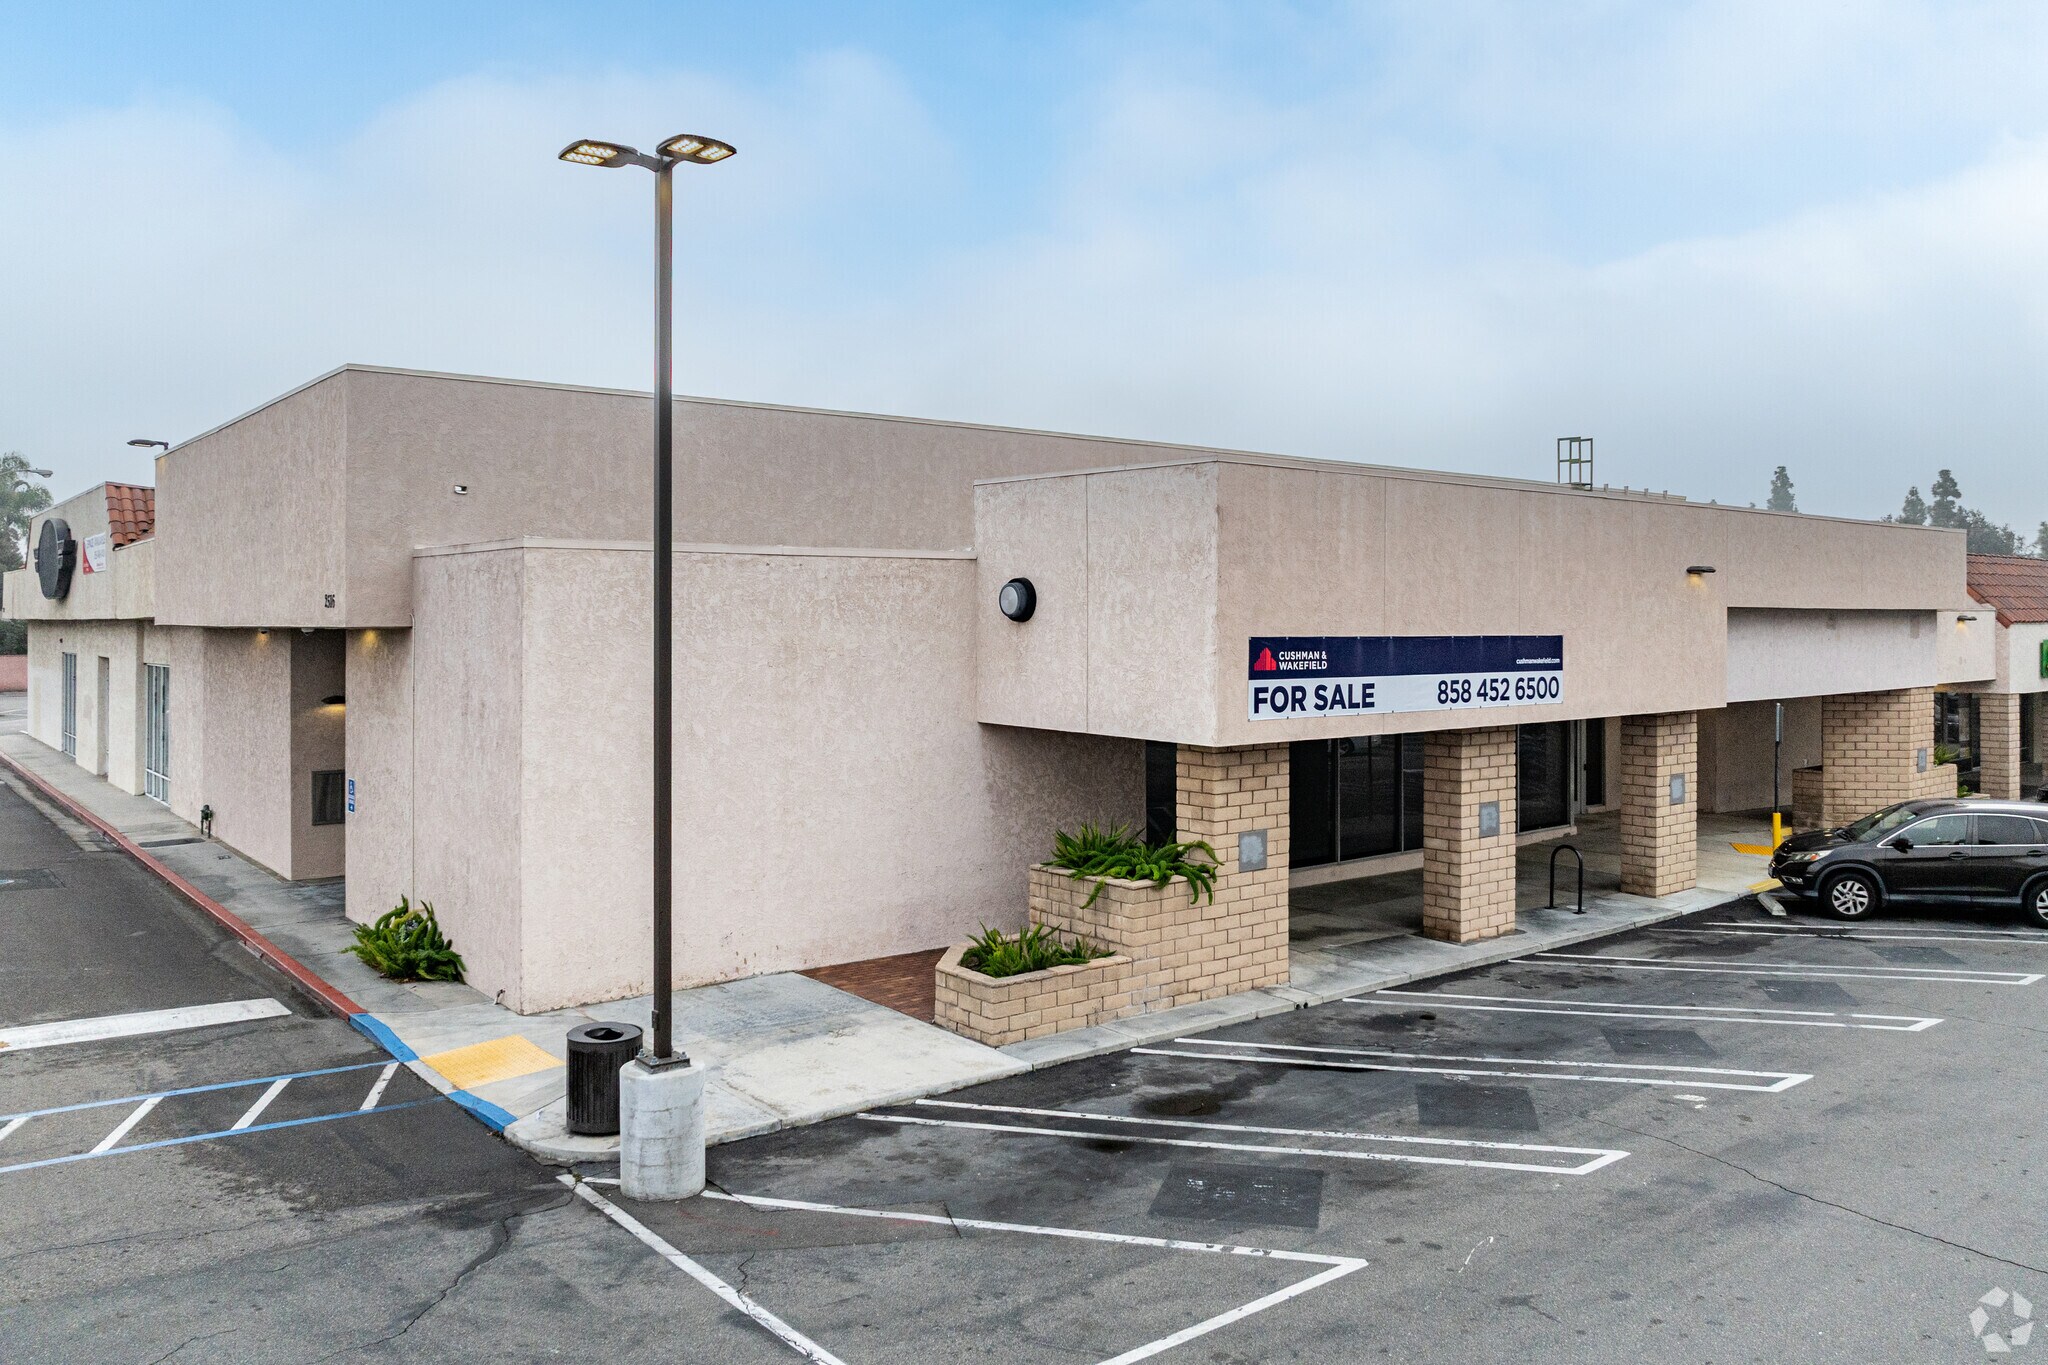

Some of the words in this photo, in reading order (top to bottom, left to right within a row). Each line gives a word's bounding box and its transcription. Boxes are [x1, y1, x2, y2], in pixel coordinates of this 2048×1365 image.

[1279, 651, 1320, 660] CUSHMAN
[1321, 651, 1328, 660] &
[1279, 661, 1328, 671] WAKEFIELD
[1254, 685, 1307, 714] FOR
[1313, 683, 1375, 711] SALE
[1437, 679, 1471, 704] 858
[1476, 678, 1510, 702] 452
[1515, 676, 1560, 700] 6500
